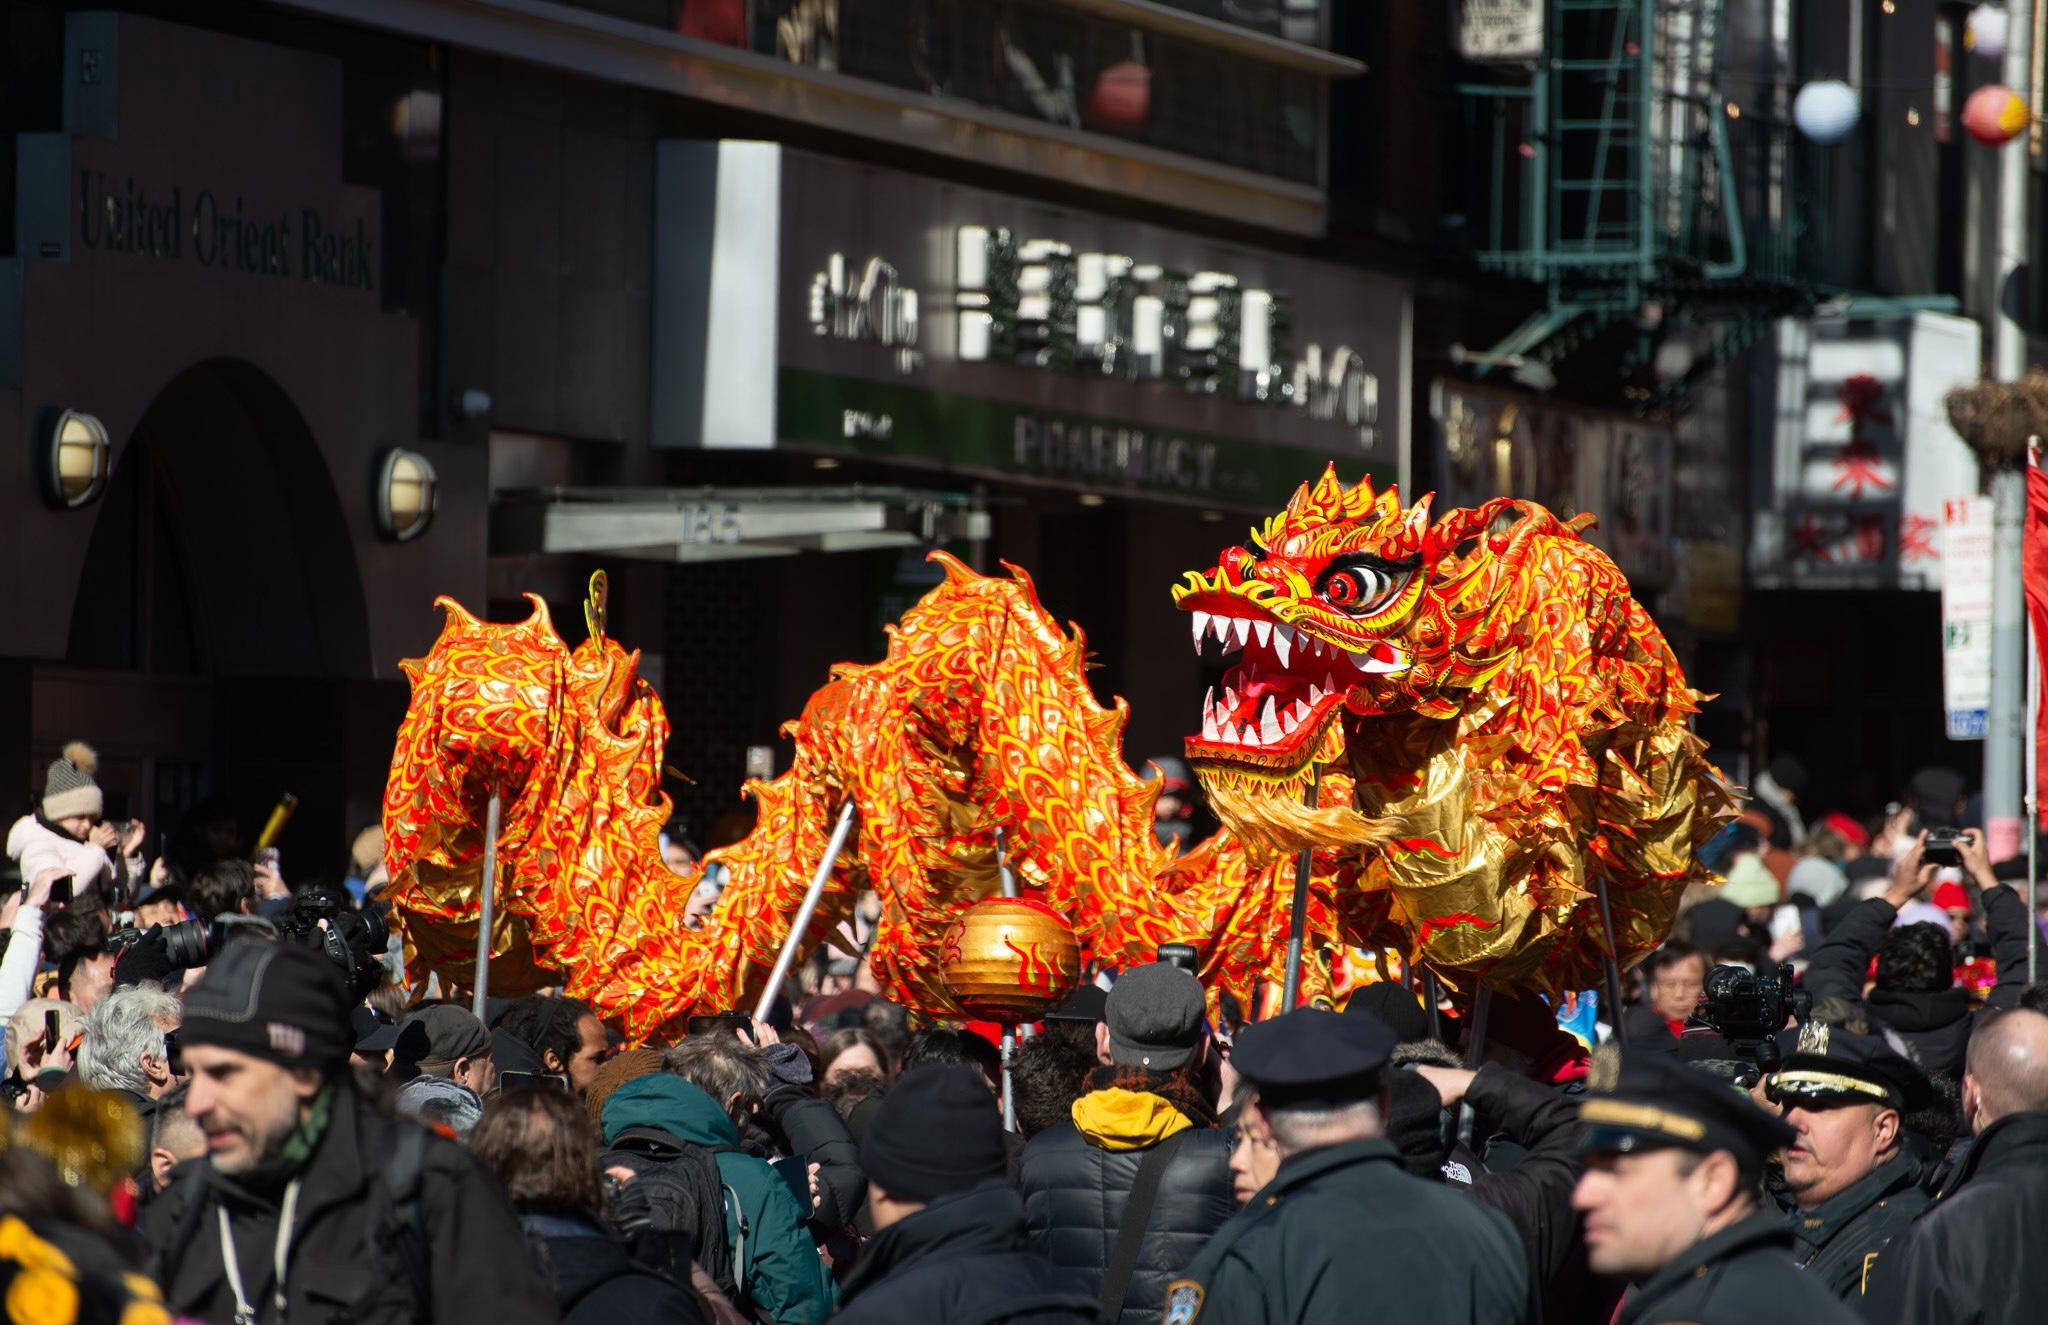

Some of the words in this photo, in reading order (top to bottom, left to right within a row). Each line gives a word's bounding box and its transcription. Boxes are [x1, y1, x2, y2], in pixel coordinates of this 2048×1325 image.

[80, 168, 182, 260] United
[192, 190, 289, 277] Orient
[299, 208, 374, 292] Bank
[1014, 414, 1217, 491] PHARMACY
[679, 501, 740, 545] 185
